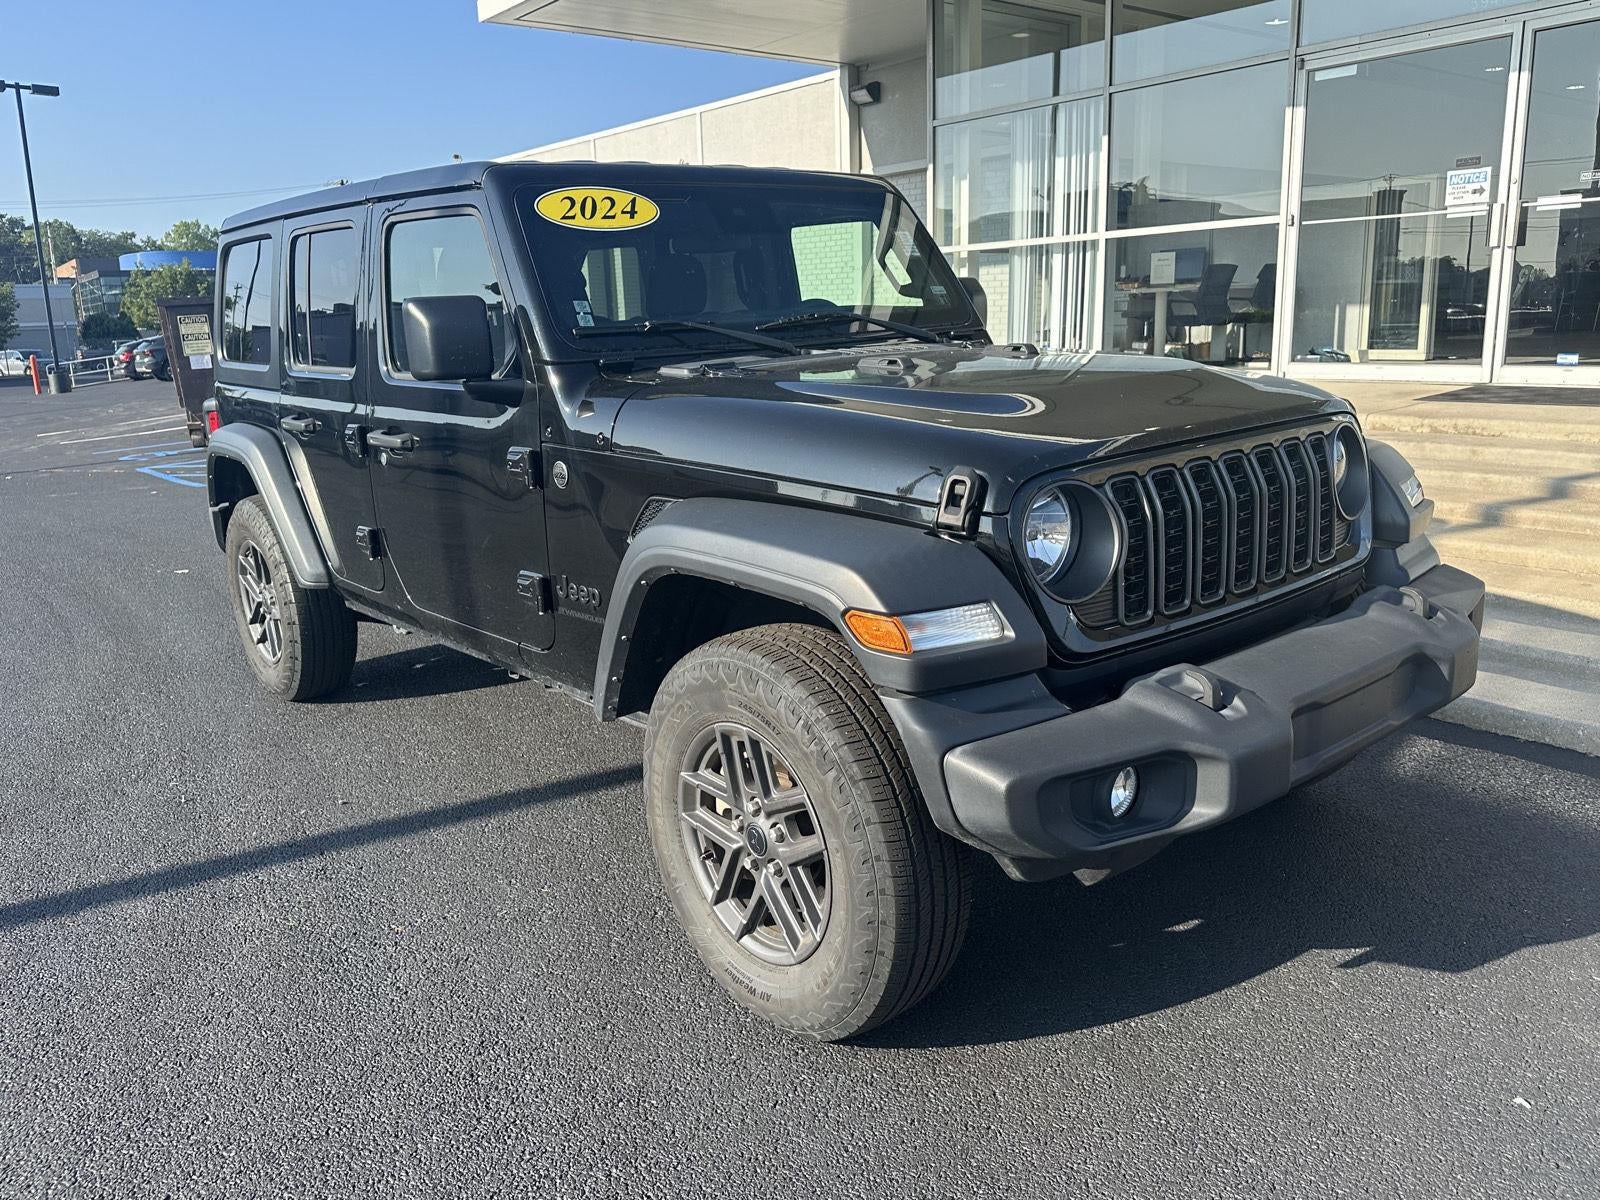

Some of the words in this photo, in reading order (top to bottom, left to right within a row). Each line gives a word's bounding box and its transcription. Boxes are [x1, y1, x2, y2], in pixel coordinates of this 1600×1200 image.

[1451, 172, 1486, 185] NOTICE
[560, 196, 638, 220] 2024
[556, 575, 600, 610] Jeep
[562, 608, 605, 624] WRANGLER
[738, 701, 781, 736] 245/75R17
[725, 967, 772, 1002] All-Weather
